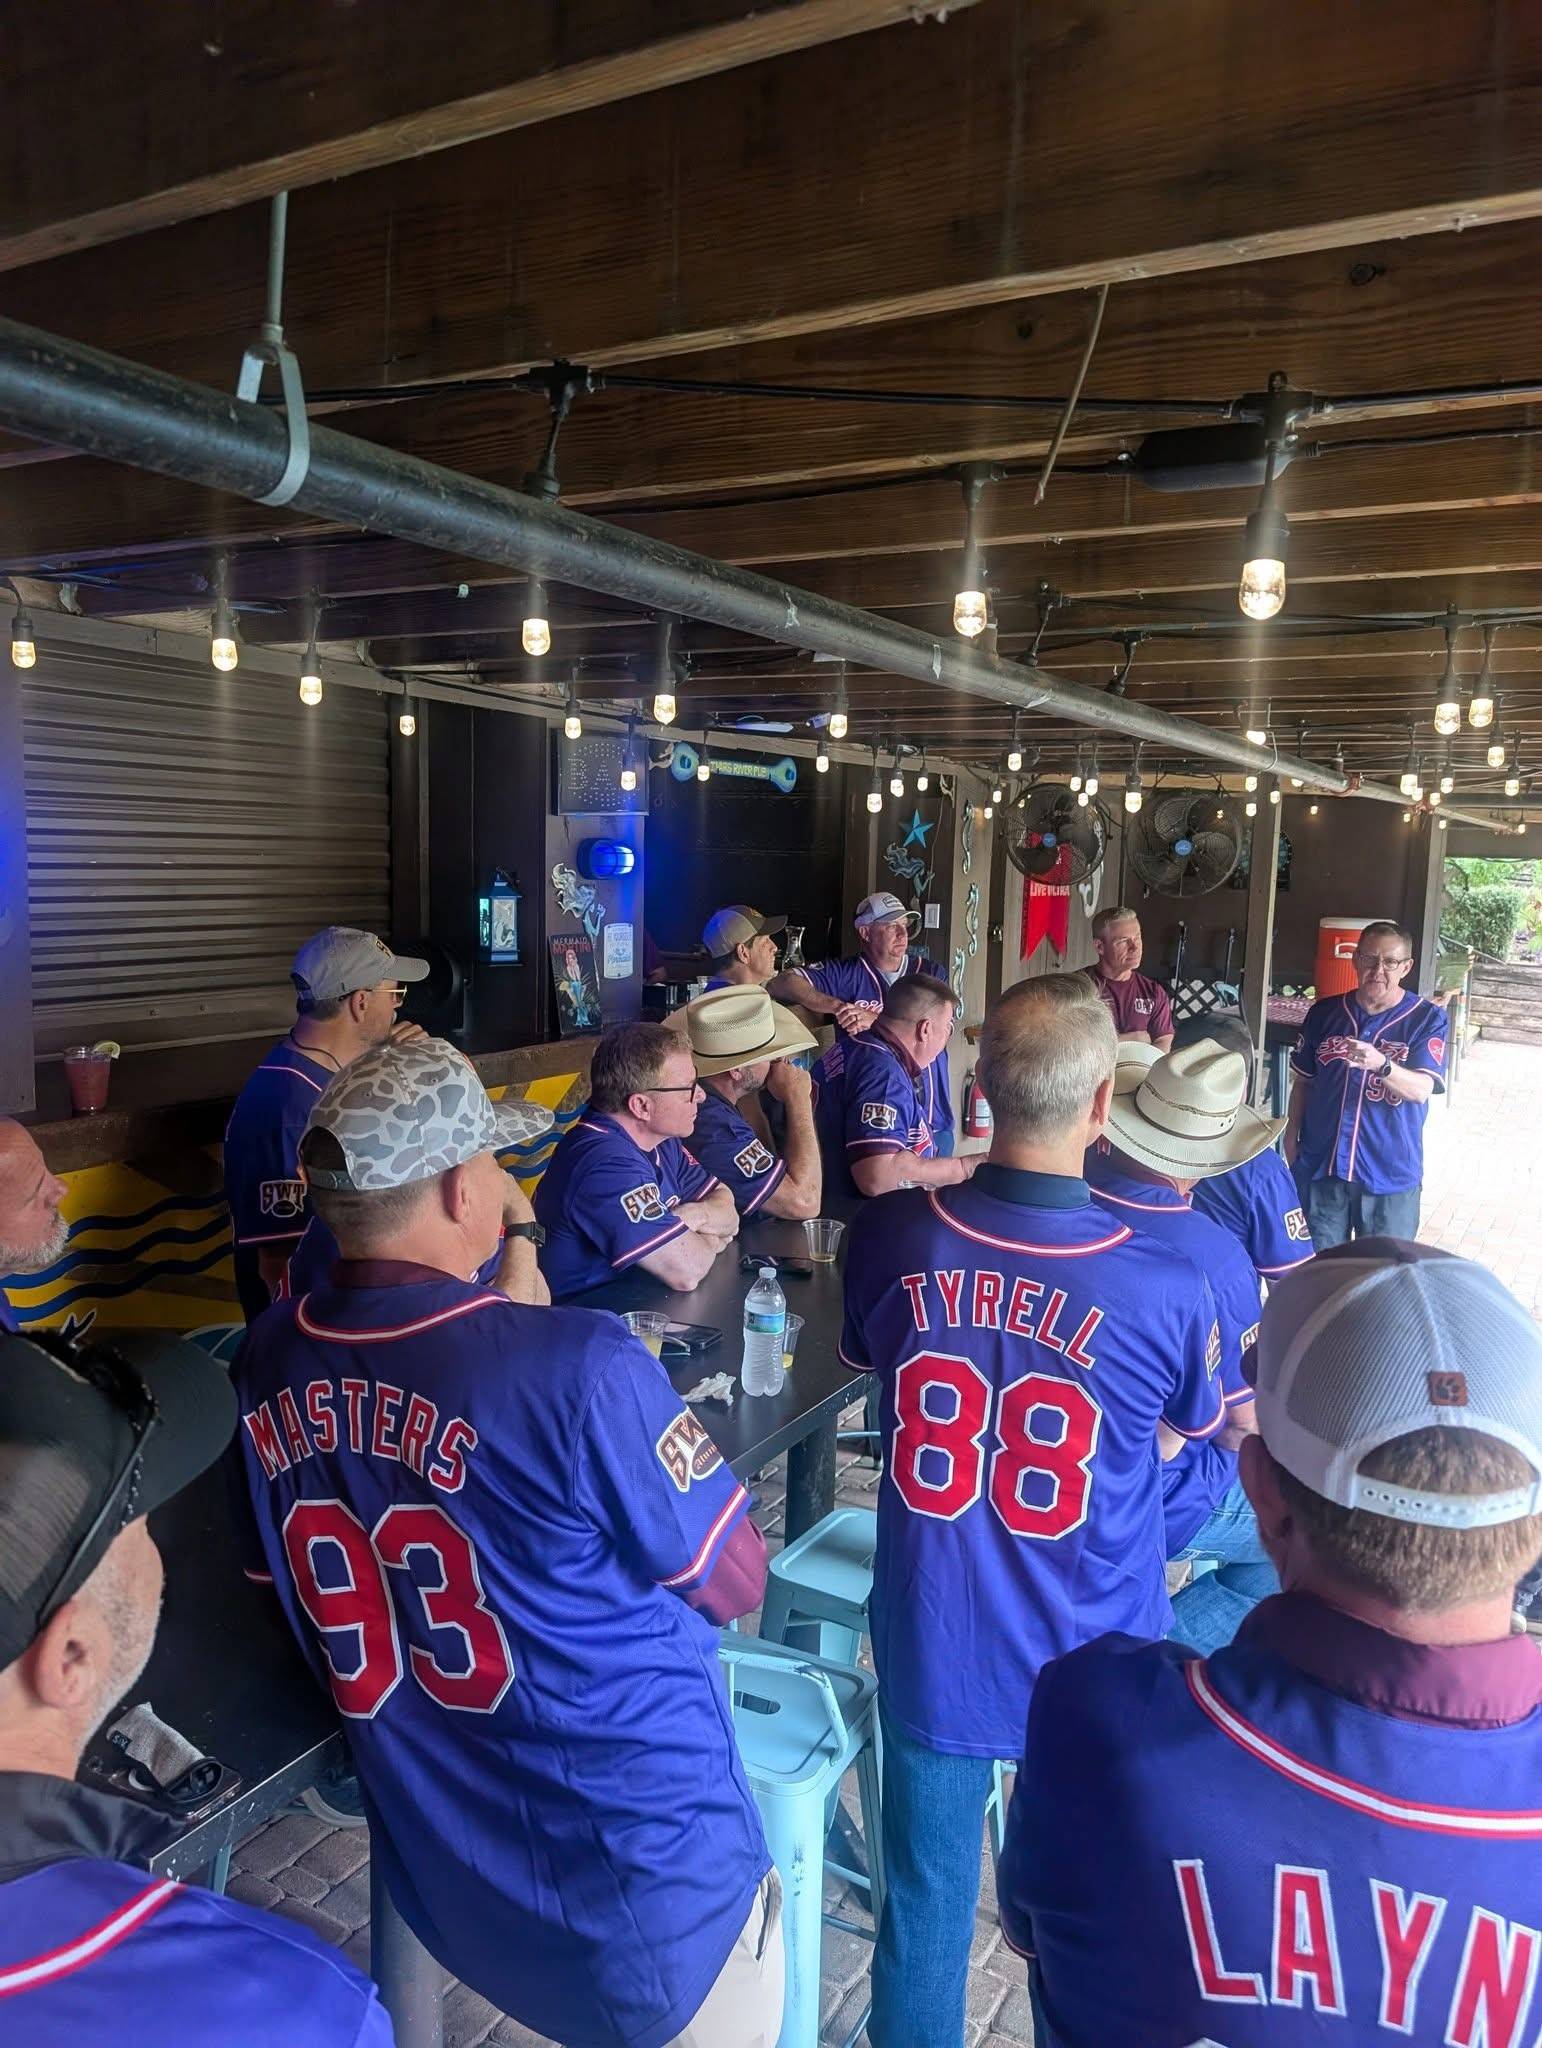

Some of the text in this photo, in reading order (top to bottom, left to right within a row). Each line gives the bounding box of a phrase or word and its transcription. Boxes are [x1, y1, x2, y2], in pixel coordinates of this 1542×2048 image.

[553, 936, 588, 945] MERMAID
[261, 1181, 306, 1211] SWT
[900, 1269, 1105, 1370] TYRELL
[243, 1378, 479, 1493] MASTERS
[890, 1350, 1103, 1541] 88
[282, 1499, 515, 1719] 93
[1173, 1859, 1542, 2048] LAYN
